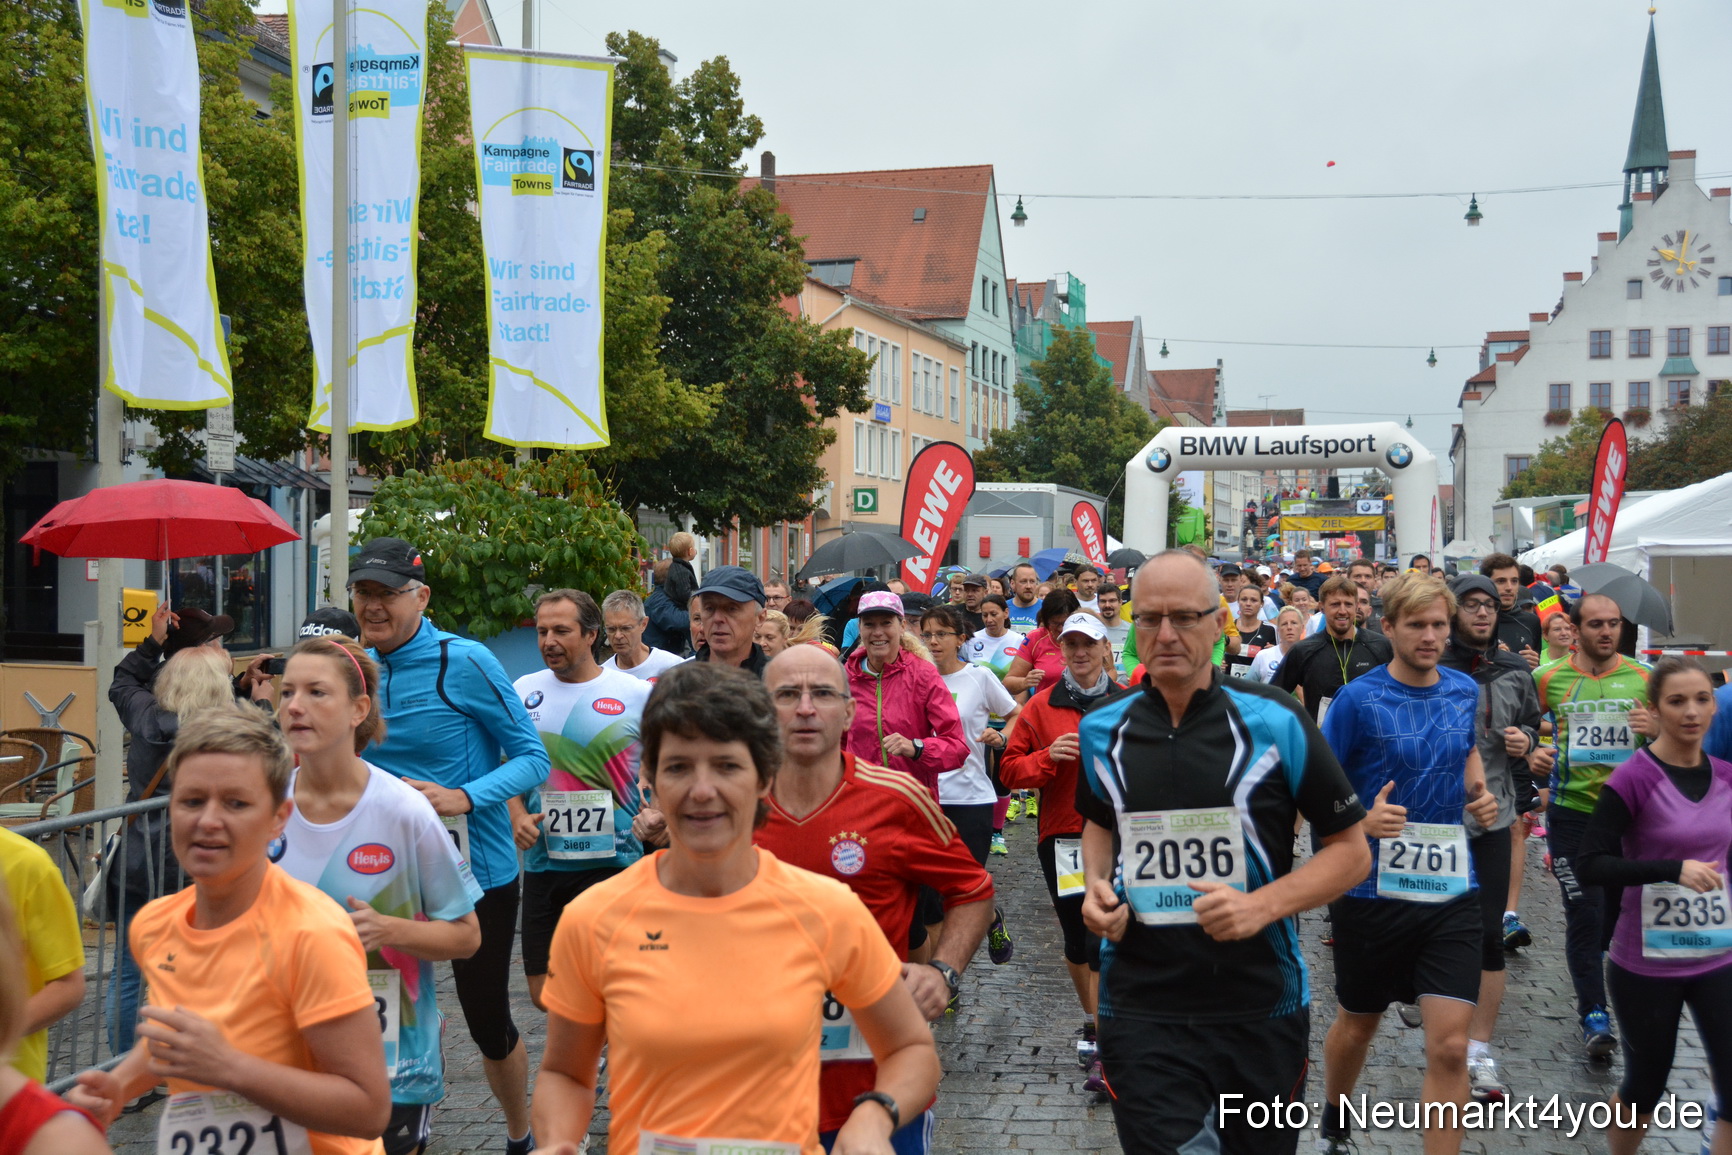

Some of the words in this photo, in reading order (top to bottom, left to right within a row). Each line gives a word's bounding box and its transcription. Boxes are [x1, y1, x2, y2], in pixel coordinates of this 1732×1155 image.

[483, 144, 550, 159] Kampagne
[483, 157, 557, 174] Fairtrade
[512, 178, 553, 190] Towns
[563, 180, 594, 190] FAIRTRADE
[489, 256, 523, 281] Wir
[529, 260, 574, 281] sind
[1180, 436, 1247, 456] BMW
[1254, 433, 1376, 458] Laufsport
[857, 491, 873, 509] D
[1587, 441, 1622, 563] REWE
[905, 459, 963, 584] REWE
[1321, 519, 1345, 528] ZIEL
[597, 701, 622, 711] Hervis
[1576, 726, 1629, 747] 2844
[1589, 752, 1616, 761] Samir
[548, 808, 607, 833] 2127
[1170, 812, 1230, 828] BOCK
[563, 840, 591, 851] Siega
[353, 852, 391, 868] Hervis
[1135, 836, 1234, 880] 2036
[1389, 841, 1457, 873] 2761
[1398, 877, 1449, 892] Matthias
[1652, 895, 1726, 927] 2335
[1671, 935, 1712, 946] Louisa
[171, 1115, 288, 1155] 2321
